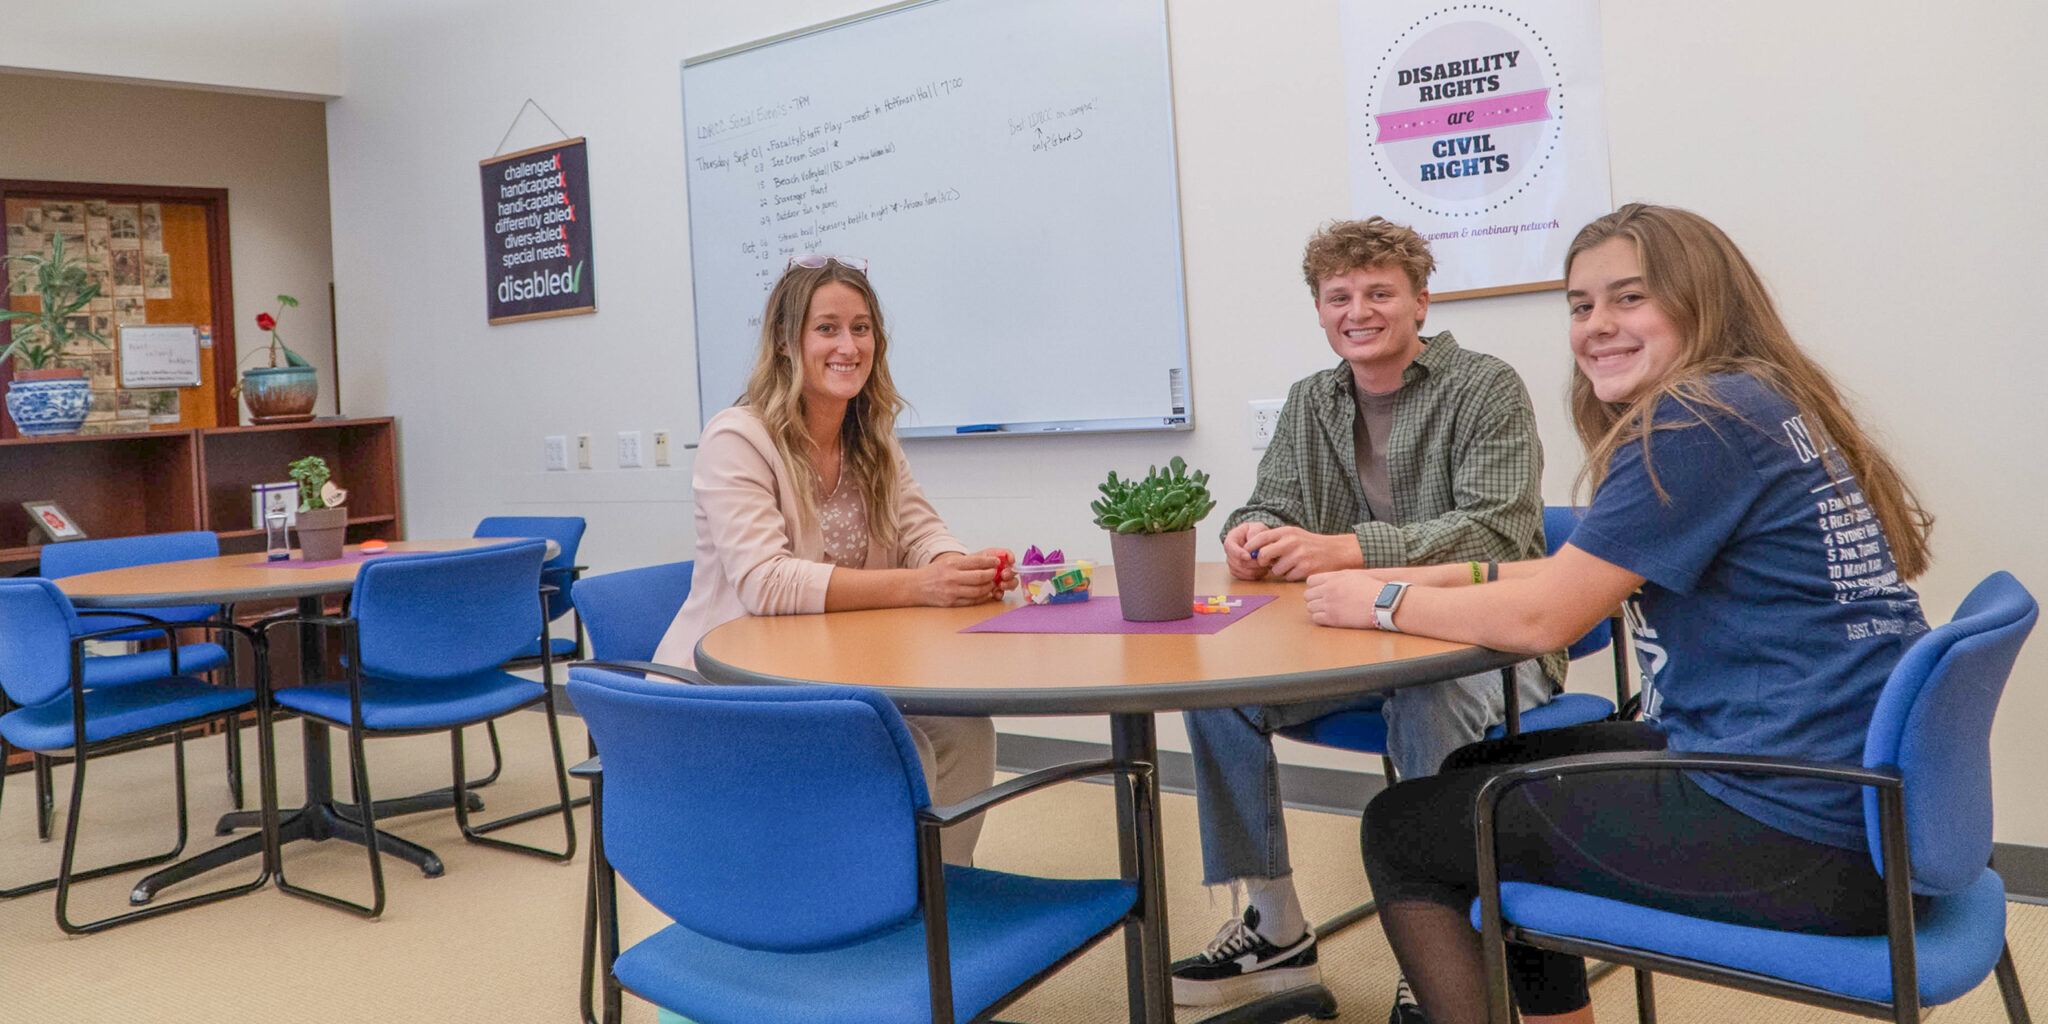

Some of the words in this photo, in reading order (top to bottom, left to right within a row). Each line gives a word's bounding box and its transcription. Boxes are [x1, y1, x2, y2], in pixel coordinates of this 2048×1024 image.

[1398, 50, 1520, 86] DISABILITY
[1419, 74, 1500, 102] RIGHTS
[696, 155, 730, 174] Thursday
[733, 148, 750, 167] Sept
[824, 121, 842, 135] Play
[916, 81, 938, 101] Hall
[1447, 110, 1475, 126] are
[808, 140, 829, 158] Social
[1432, 134, 1495, 158] CIVIL
[504, 156, 556, 181] challenged
[1420, 154, 1510, 182] RIGHTS
[501, 173, 561, 198] handicapped
[773, 173, 800, 188] Beach
[498, 192, 564, 217] handi-capable
[774, 192, 807, 205] Scavenger
[810, 183, 828, 196] Hunt
[495, 212, 542, 234] differently
[543, 206, 572, 225] abled
[1428, 231, 1459, 241] women
[1461, 228, 1469, 238] &
[1471, 224, 1519, 236] nonbinary
[1520, 219, 1560, 231] network
[505, 225, 562, 249] divers-abled
[742, 241, 756, 254] Oct
[503, 248, 535, 268] special
[536, 243, 567, 261] needs
[498, 265, 573, 303] disabled
[1819, 518, 1829, 530] 2
[1828, 513, 1854, 529] RILEY
[1823, 533, 1834, 547] 4
[1835, 527, 1867, 544] SYDNEY
[1828, 549, 1836, 562] 5
[1839, 548, 1859, 561] AVA
[1828, 565, 1841, 579] 10
[1844, 562, 1867, 577] MAYA
[1847, 622, 1874, 641] ASST.
